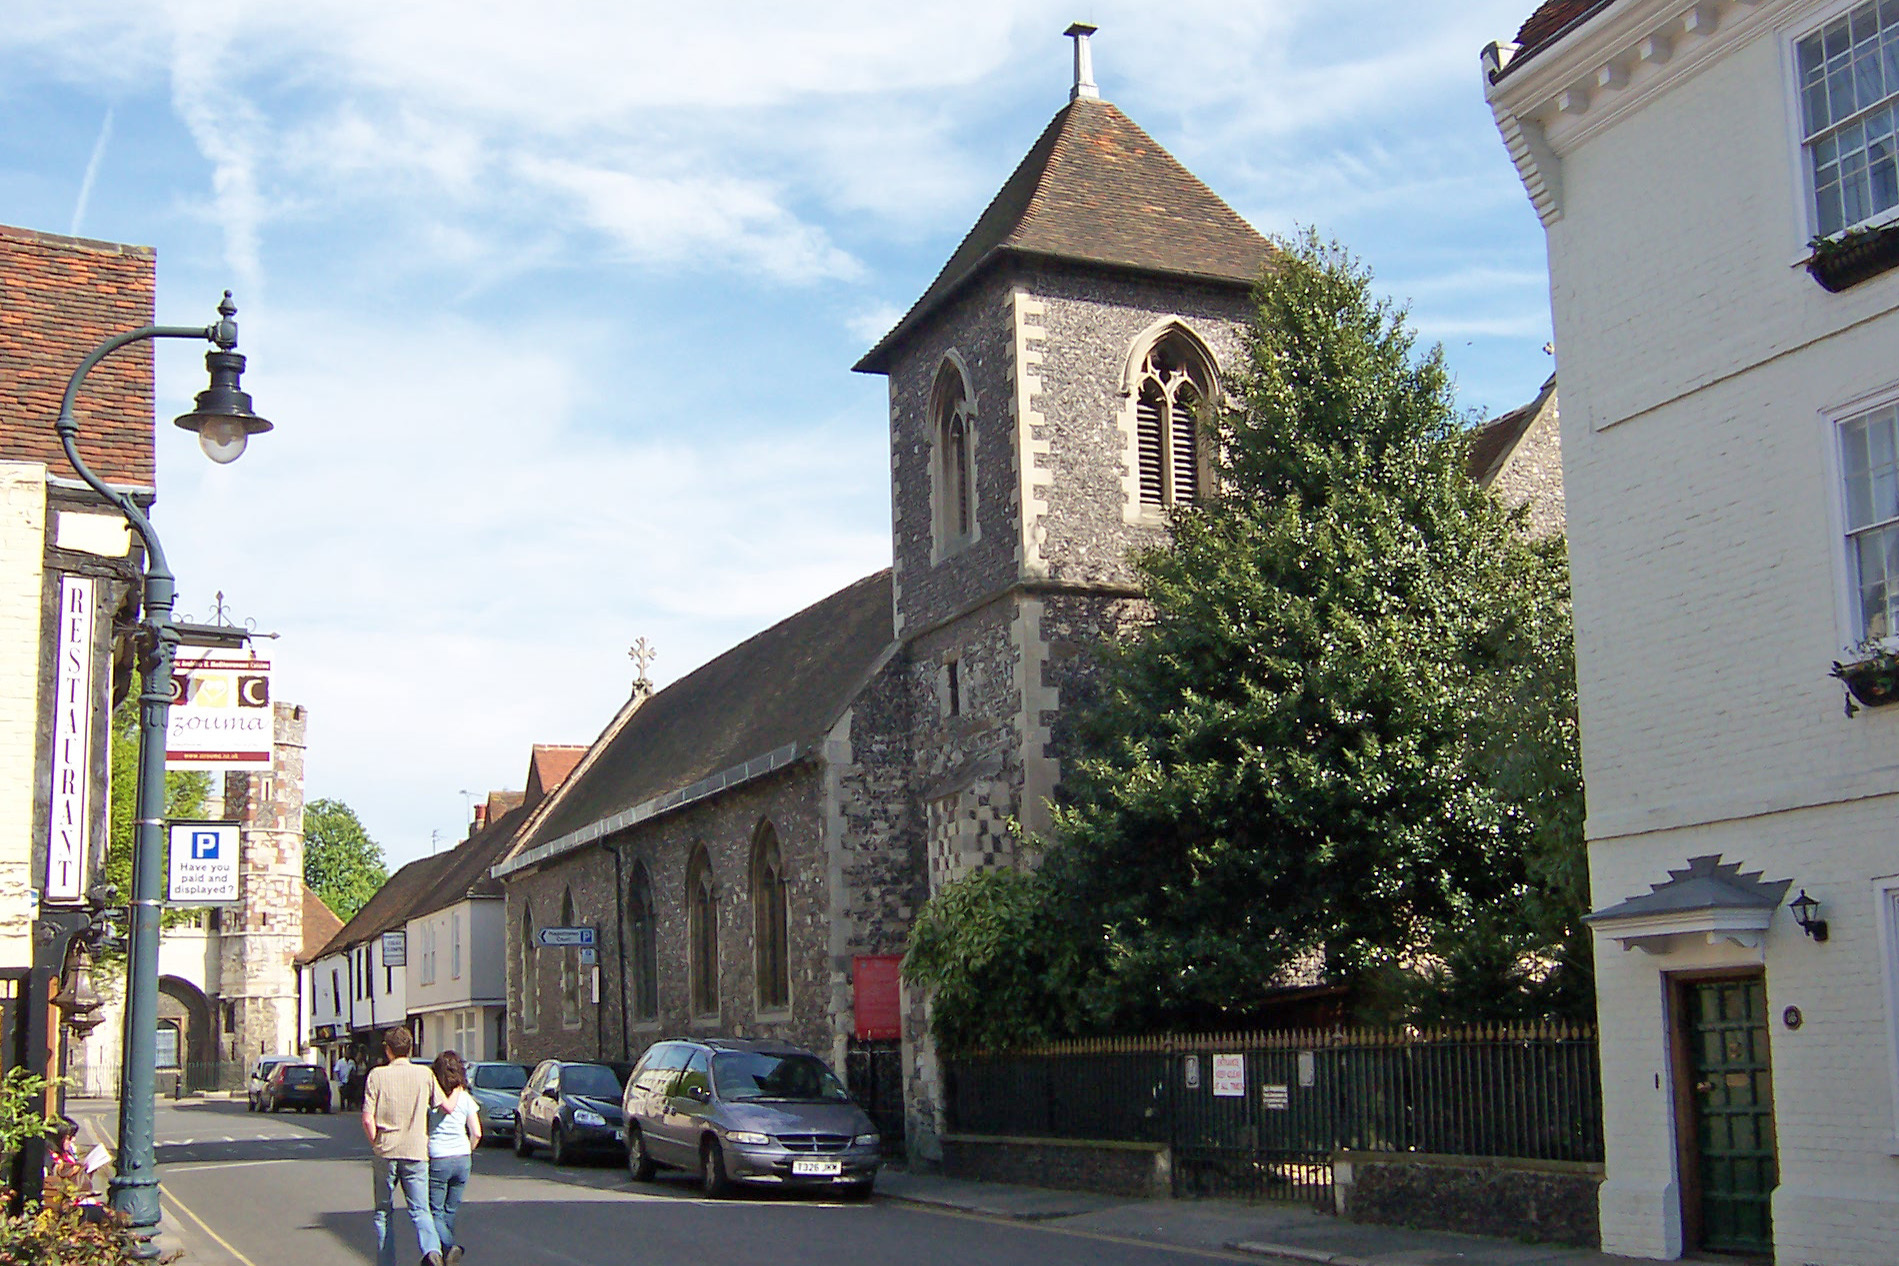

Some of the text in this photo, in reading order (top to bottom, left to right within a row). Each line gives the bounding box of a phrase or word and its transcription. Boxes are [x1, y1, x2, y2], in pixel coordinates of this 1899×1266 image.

[58, 587, 83, 887] RESTAURANT
[173, 716, 268, 737] zouma
[197, 834, 216, 858] P
[180, 863, 230, 873] Have you
[181, 874, 228, 883] paid and
